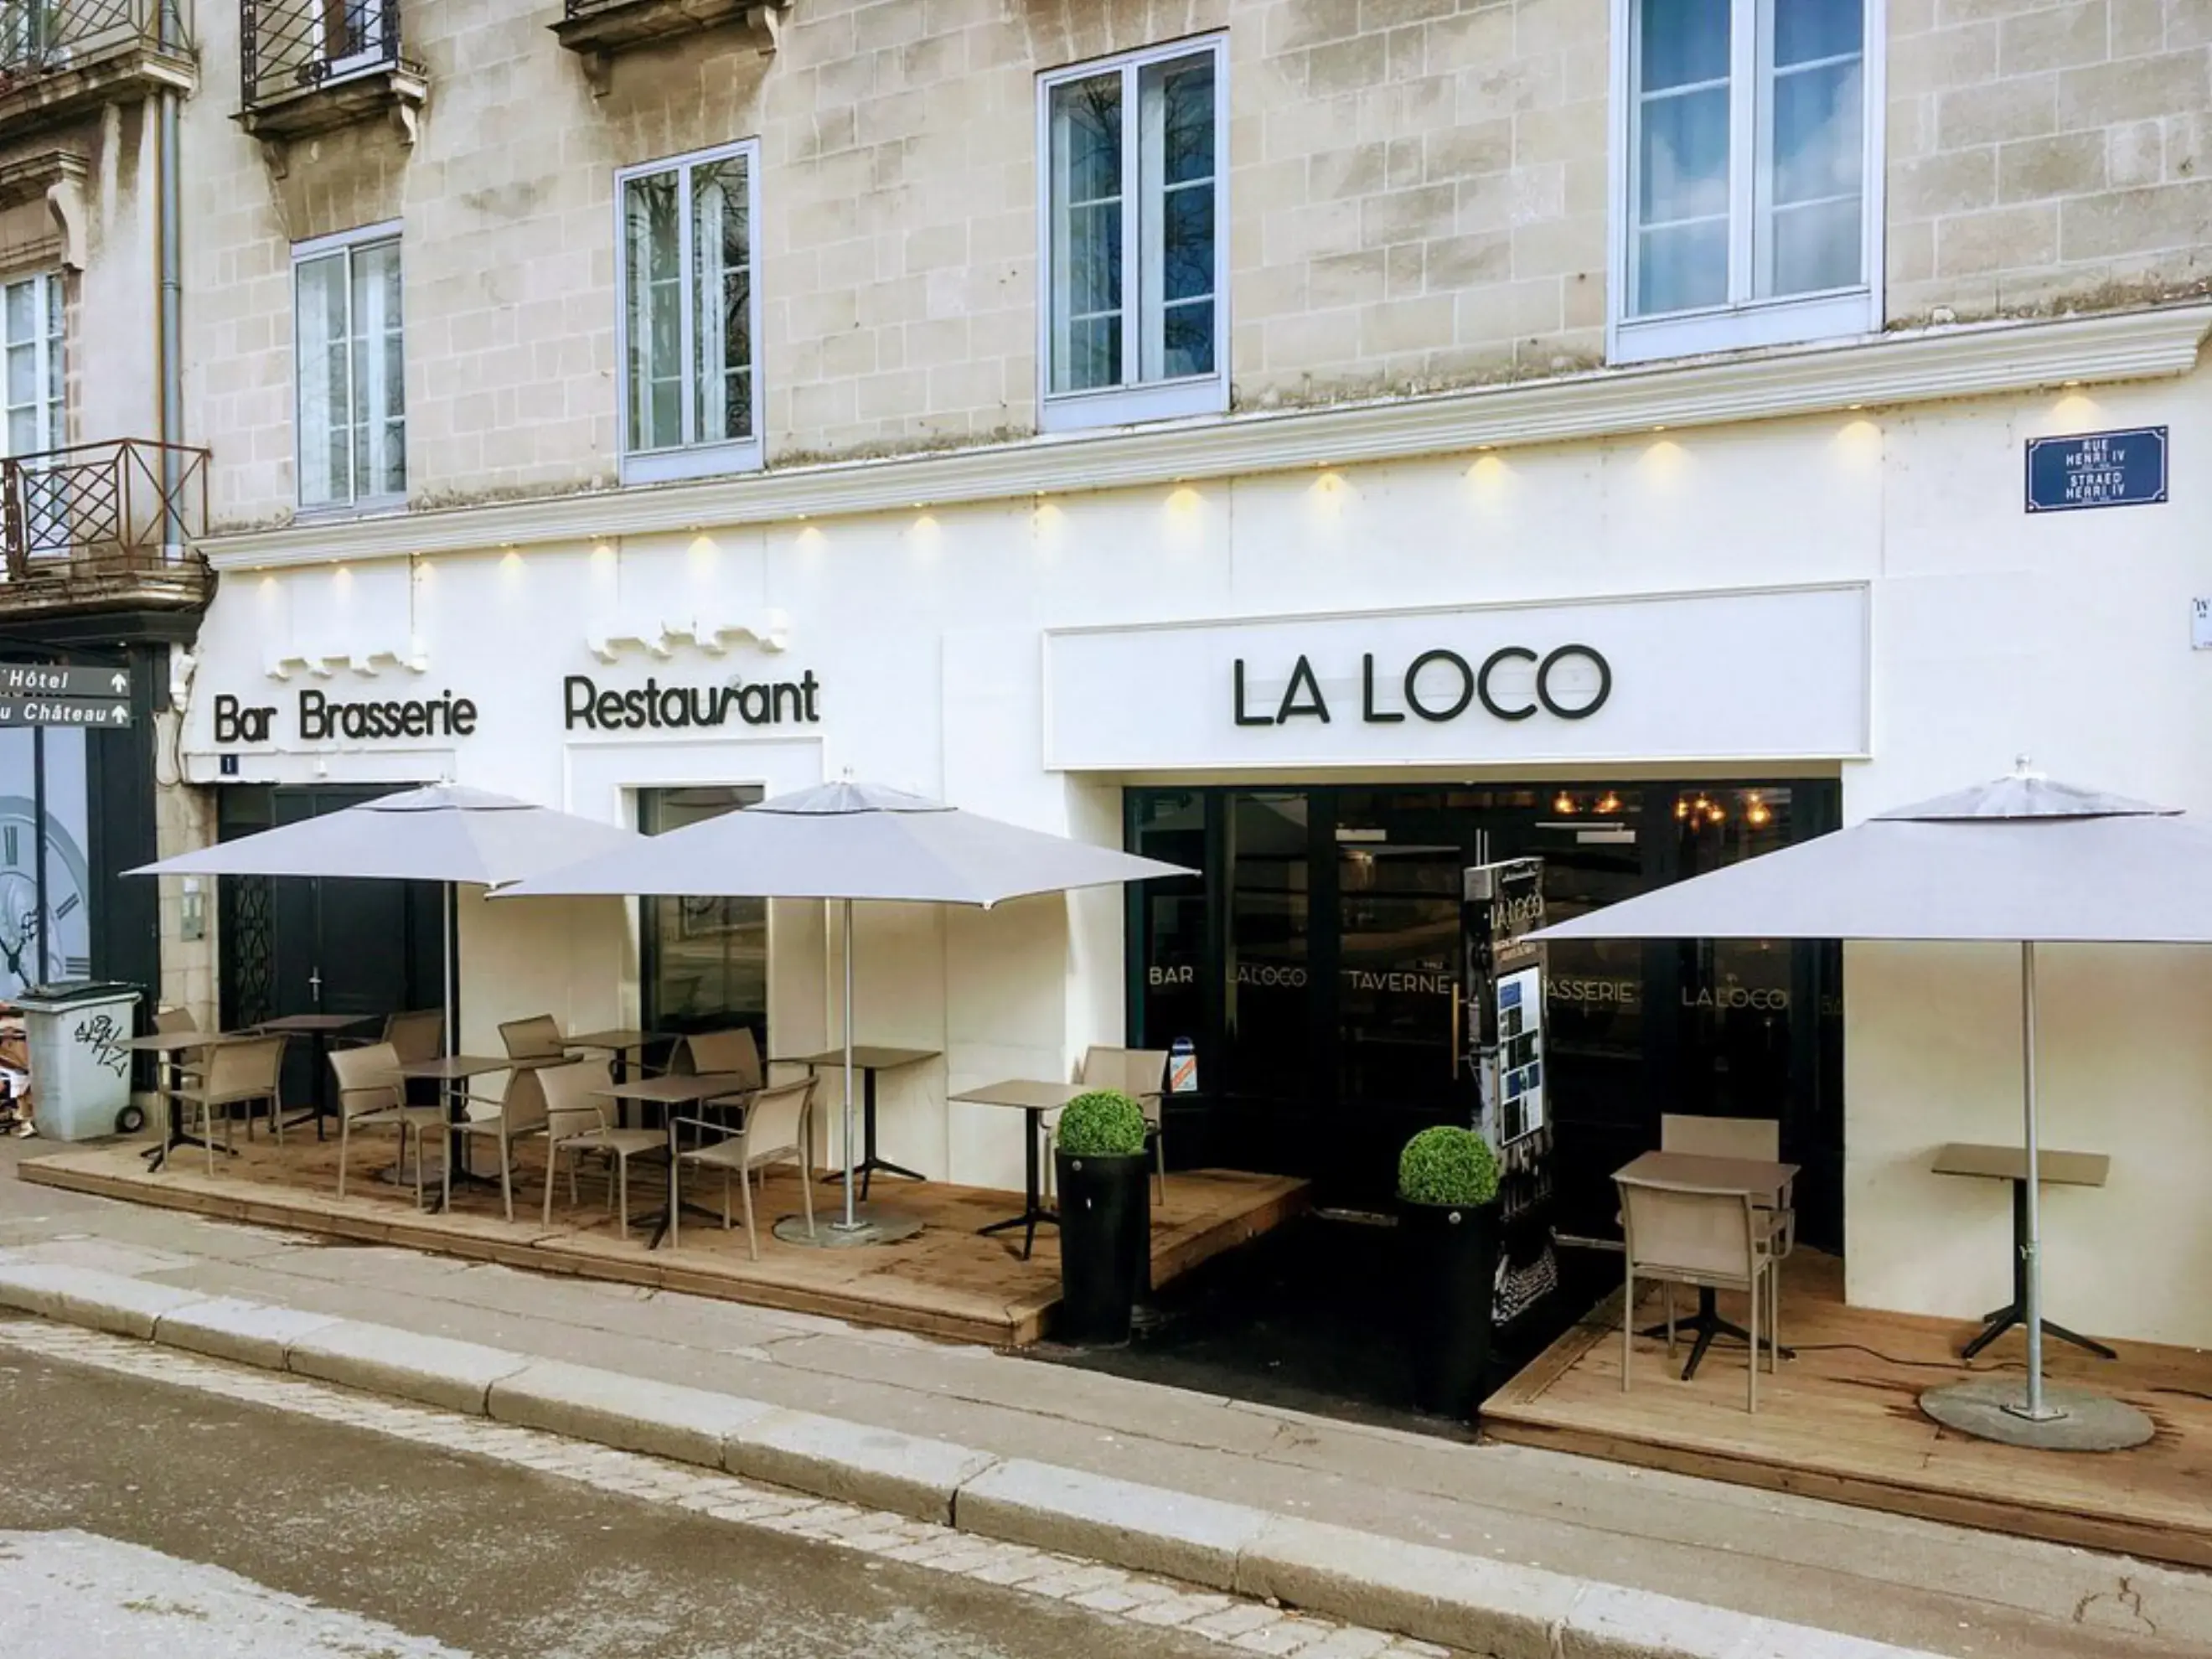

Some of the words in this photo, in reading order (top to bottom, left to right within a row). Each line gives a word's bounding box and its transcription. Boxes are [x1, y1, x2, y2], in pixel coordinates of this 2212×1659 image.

[2082, 439, 2109, 452] RUE
[2065, 452, 2107, 467] HENRI
[2112, 449, 2125, 463] IV
[2070, 471, 2122, 487] STRAED
[2112, 483, 2125, 496] IV
[1234, 654, 1331, 726] LA
[1362, 643, 1612, 723] LOCO
[564, 669, 820, 731] Restaurant
[23, 702, 107, 722] Château
[214, 694, 278, 742] Bar
[299, 689, 478, 740] Brasserie
[1150, 965, 1193, 985] BAR
[1348, 970, 1450, 995] TAVERNE
[1548, 979, 1636, 1004] ASSERIE
